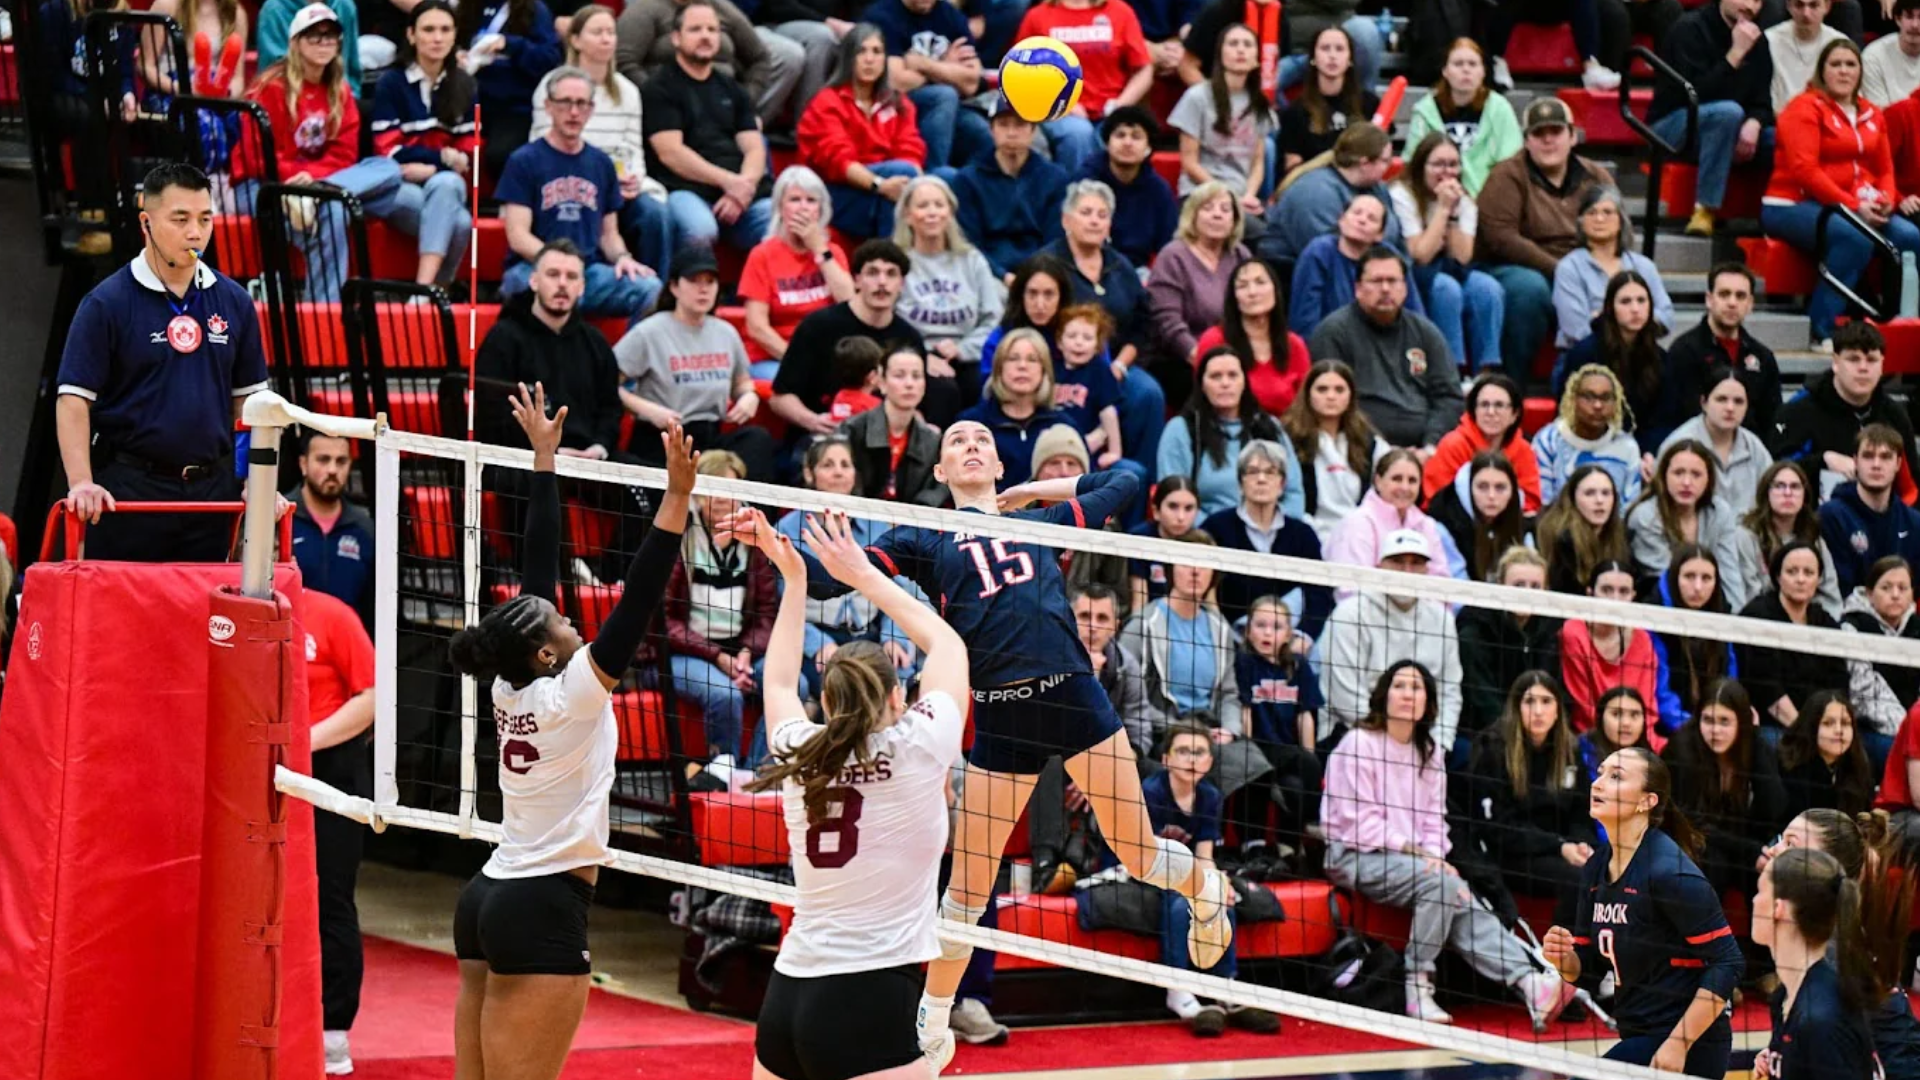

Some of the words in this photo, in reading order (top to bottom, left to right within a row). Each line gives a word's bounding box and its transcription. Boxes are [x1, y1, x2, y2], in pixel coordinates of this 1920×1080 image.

[958, 538, 1035, 599] 15
[988, 685, 1033, 703] PRO
[1040, 673, 1073, 693] NI
[803, 786, 865, 869] 8
[1598, 929, 1622, 987] 9
